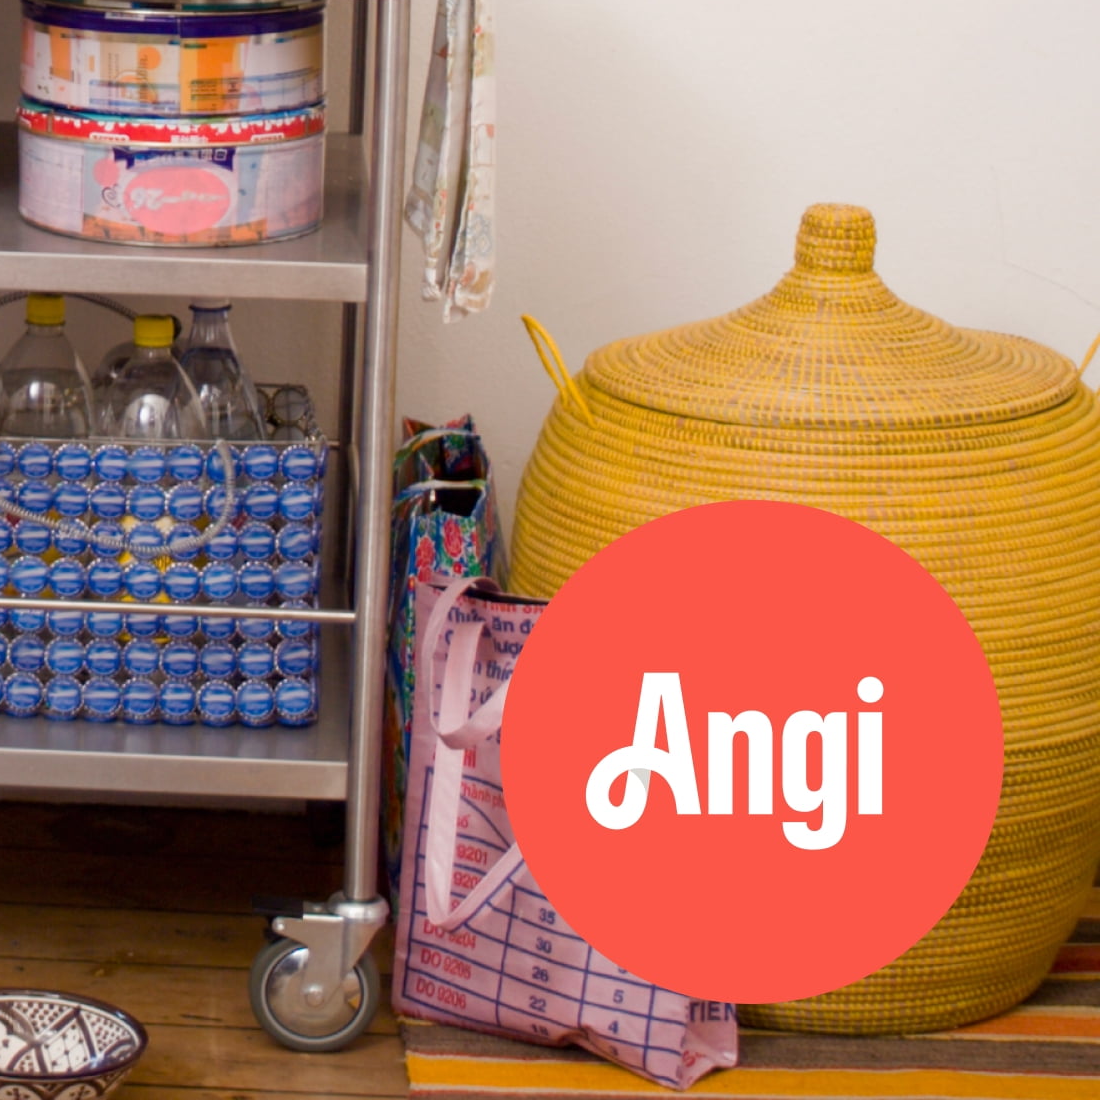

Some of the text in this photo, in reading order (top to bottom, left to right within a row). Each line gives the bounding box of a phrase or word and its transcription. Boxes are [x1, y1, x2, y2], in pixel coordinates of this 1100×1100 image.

[539, 907, 557, 925] 35
[536, 936, 552, 954] 30
[420, 948, 442, 968] DO
[416, 977, 436, 998] DO
[529, 995, 547, 1013] 22
[613, 989, 625, 1004] 5
[608, 1020, 620, 1035] 4
